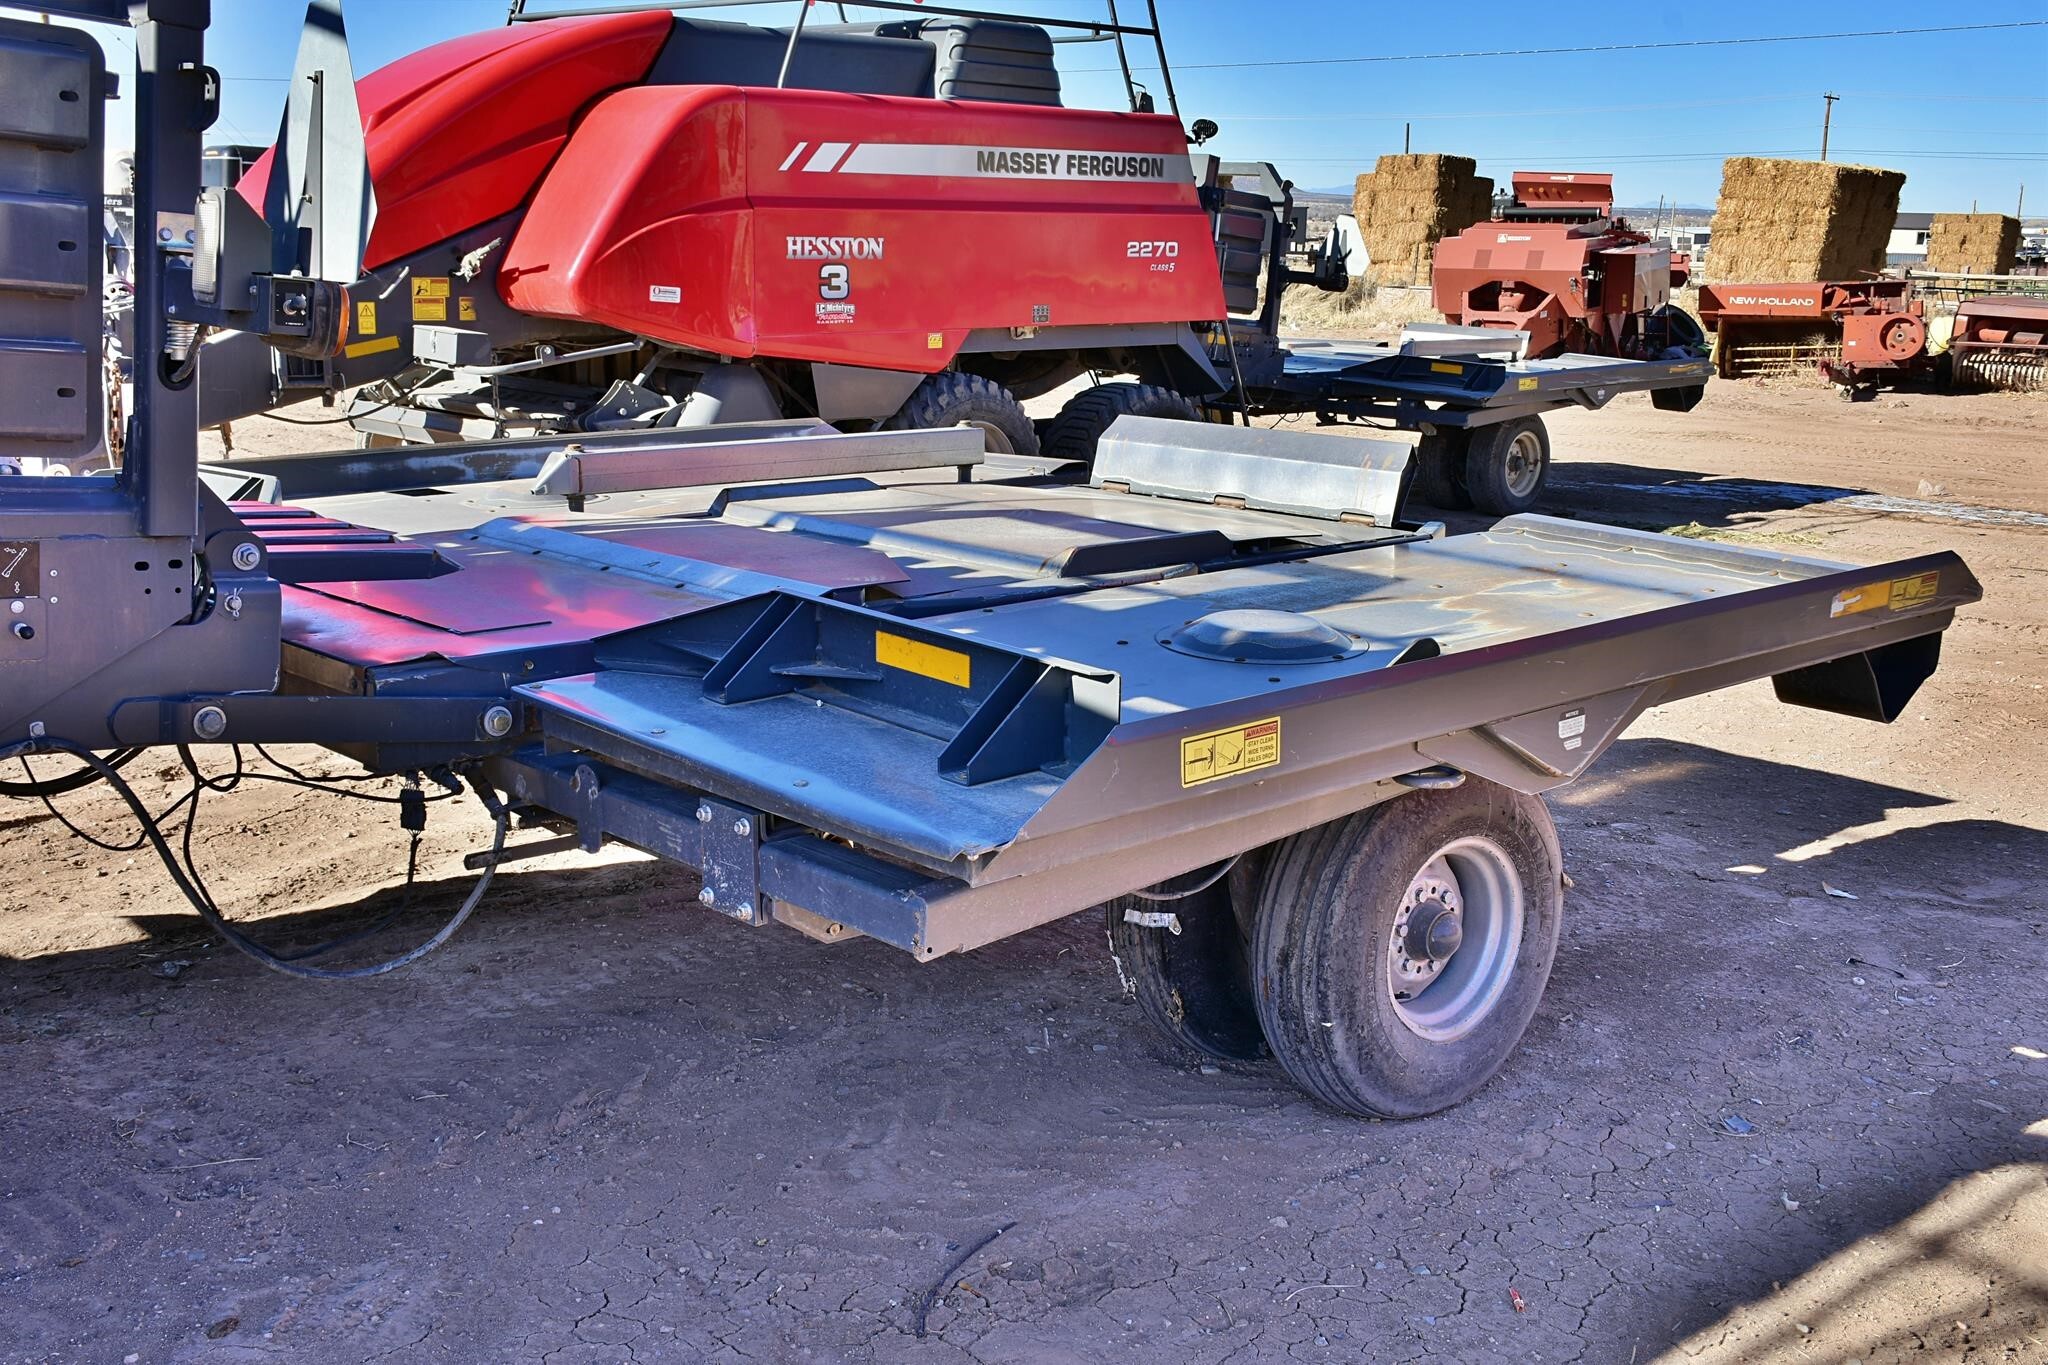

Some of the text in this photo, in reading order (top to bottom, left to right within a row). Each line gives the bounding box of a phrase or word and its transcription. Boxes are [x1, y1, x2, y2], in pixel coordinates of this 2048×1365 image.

[977, 150, 1164, 178] MASSEY FERGUSON
[786, 236, 885, 260] HESSTON
[1127, 241, 1178, 257] 2270
[1150, 262, 1175, 272] CLASS 5
[819, 262, 849, 300] 3
[1729, 296, 1814, 306] NEW HOLLAND
[1250, 723, 1277, 736] WARNING
